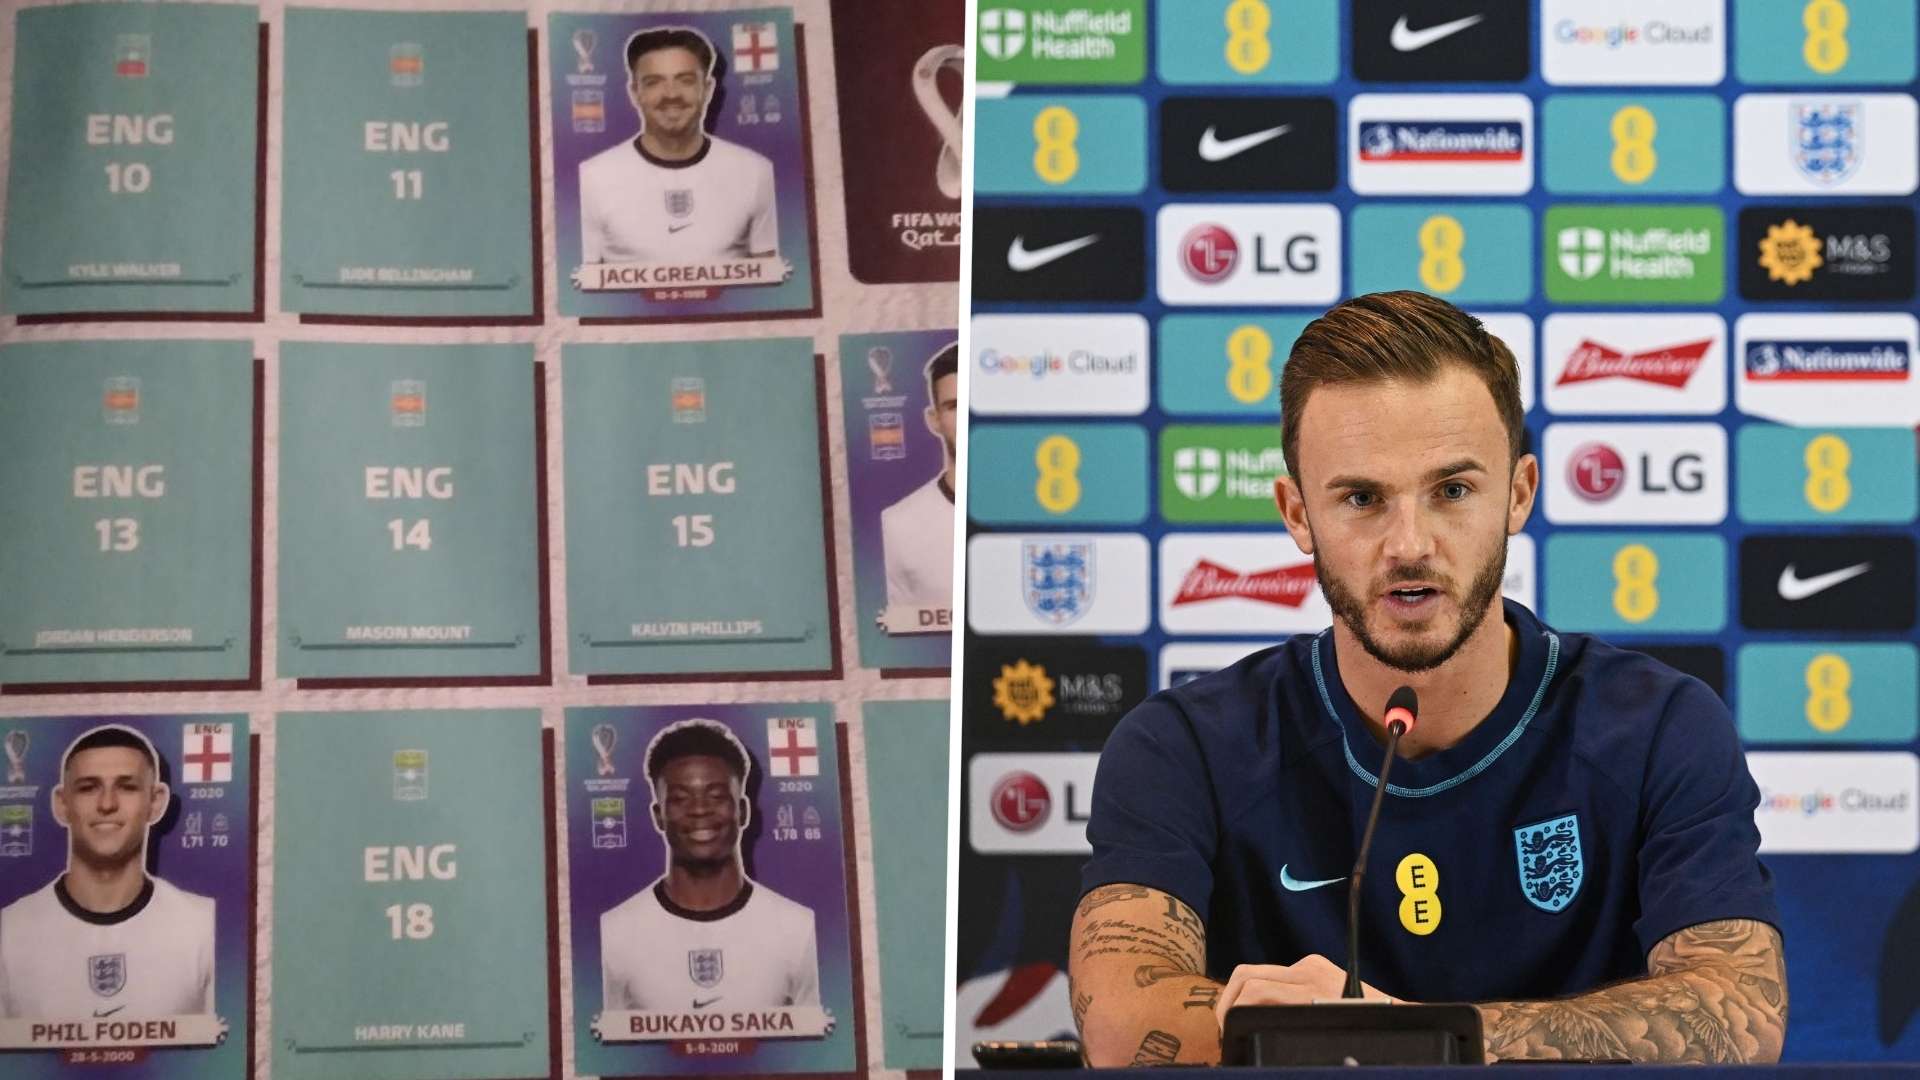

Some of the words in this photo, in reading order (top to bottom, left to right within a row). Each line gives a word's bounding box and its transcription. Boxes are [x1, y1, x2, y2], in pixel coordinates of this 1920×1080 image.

[1032, 9, 1131, 35] Nuffield
[1554, 19, 1639, 50] Google
[1643, 20, 1712, 45] Cloud
[1032, 35, 1114, 59] Health
[87, 114, 174, 145] ENG
[364, 122, 449, 152] ENG
[1396, 127, 1520, 152] Nationwide
[105, 163, 151, 193] 10
[390, 170, 423, 199] 11
[892, 213, 934, 228] FIFA
[1254, 235, 1319, 273] LG
[1610, 228, 1710, 254] Nuffield
[1827, 234, 1891, 261] M&S
[601, 268, 648, 289] JACK
[653, 263, 762, 283] GREALISH
[1610, 256, 1695, 279] Health
[979, 349, 1063, 380] Google
[1068, 350, 1138, 375] Cloud
[1783, 347, 1907, 371] Nationwide
[1226, 449, 1287, 472] Nuff
[73, 465, 165, 498] ENG
[365, 467, 453, 499] ENG
[647, 462, 736, 496] ENG
[1226, 475, 1275, 499] Hea
[1640, 455, 1705, 493] LG
[95, 519, 140, 551] 13
[387, 519, 432, 551] 14
[672, 515, 715, 547] 15
[691, 620, 762, 636] PHILLIPS
[918, 609, 953, 626] DE
[346, 625, 408, 640] MASON
[410, 625, 472, 640] MOUNT
[778, 719, 805, 729] ENG
[190, 787, 224, 799] 2020
[780, 781, 813, 792] 2020
[1840, 787, 1910, 812] Cloud
[1065, 782, 1090, 823] L
[212, 835, 228, 847] 70
[363, 844, 457, 882] ENG
[385, 904, 435, 940] 18
[32, 1023, 89, 1041] PHIL
[96, 1020, 177, 1041] FODEN
[354, 1024, 413, 1041] HARRY
[417, 1023, 465, 1039] KANE
[630, 1014, 725, 1033] BUKAYO
[731, 1012, 794, 1031] SAKA
